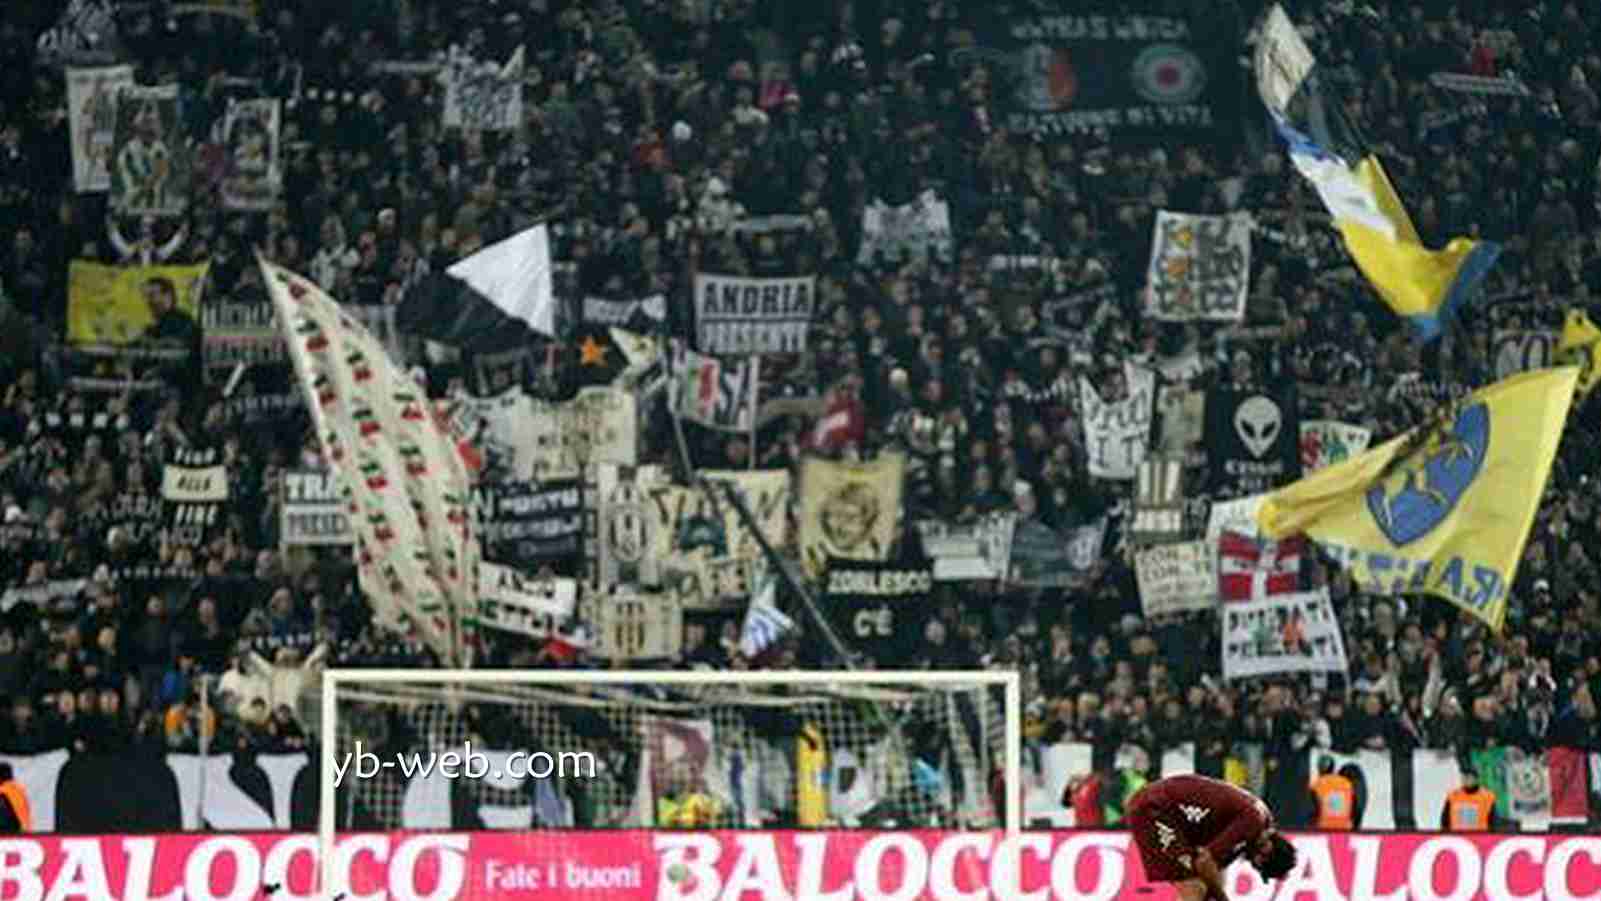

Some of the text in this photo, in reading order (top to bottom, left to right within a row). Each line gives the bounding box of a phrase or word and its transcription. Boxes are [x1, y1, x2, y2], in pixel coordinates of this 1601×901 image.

[703, 281, 810, 314] ANDRIA
[0, 832, 470, 901] BALOCCO
[486, 863, 543, 889] Fate
[567, 862, 642, 889] buoni
[652, 831, 1134, 901] BALOCCO
